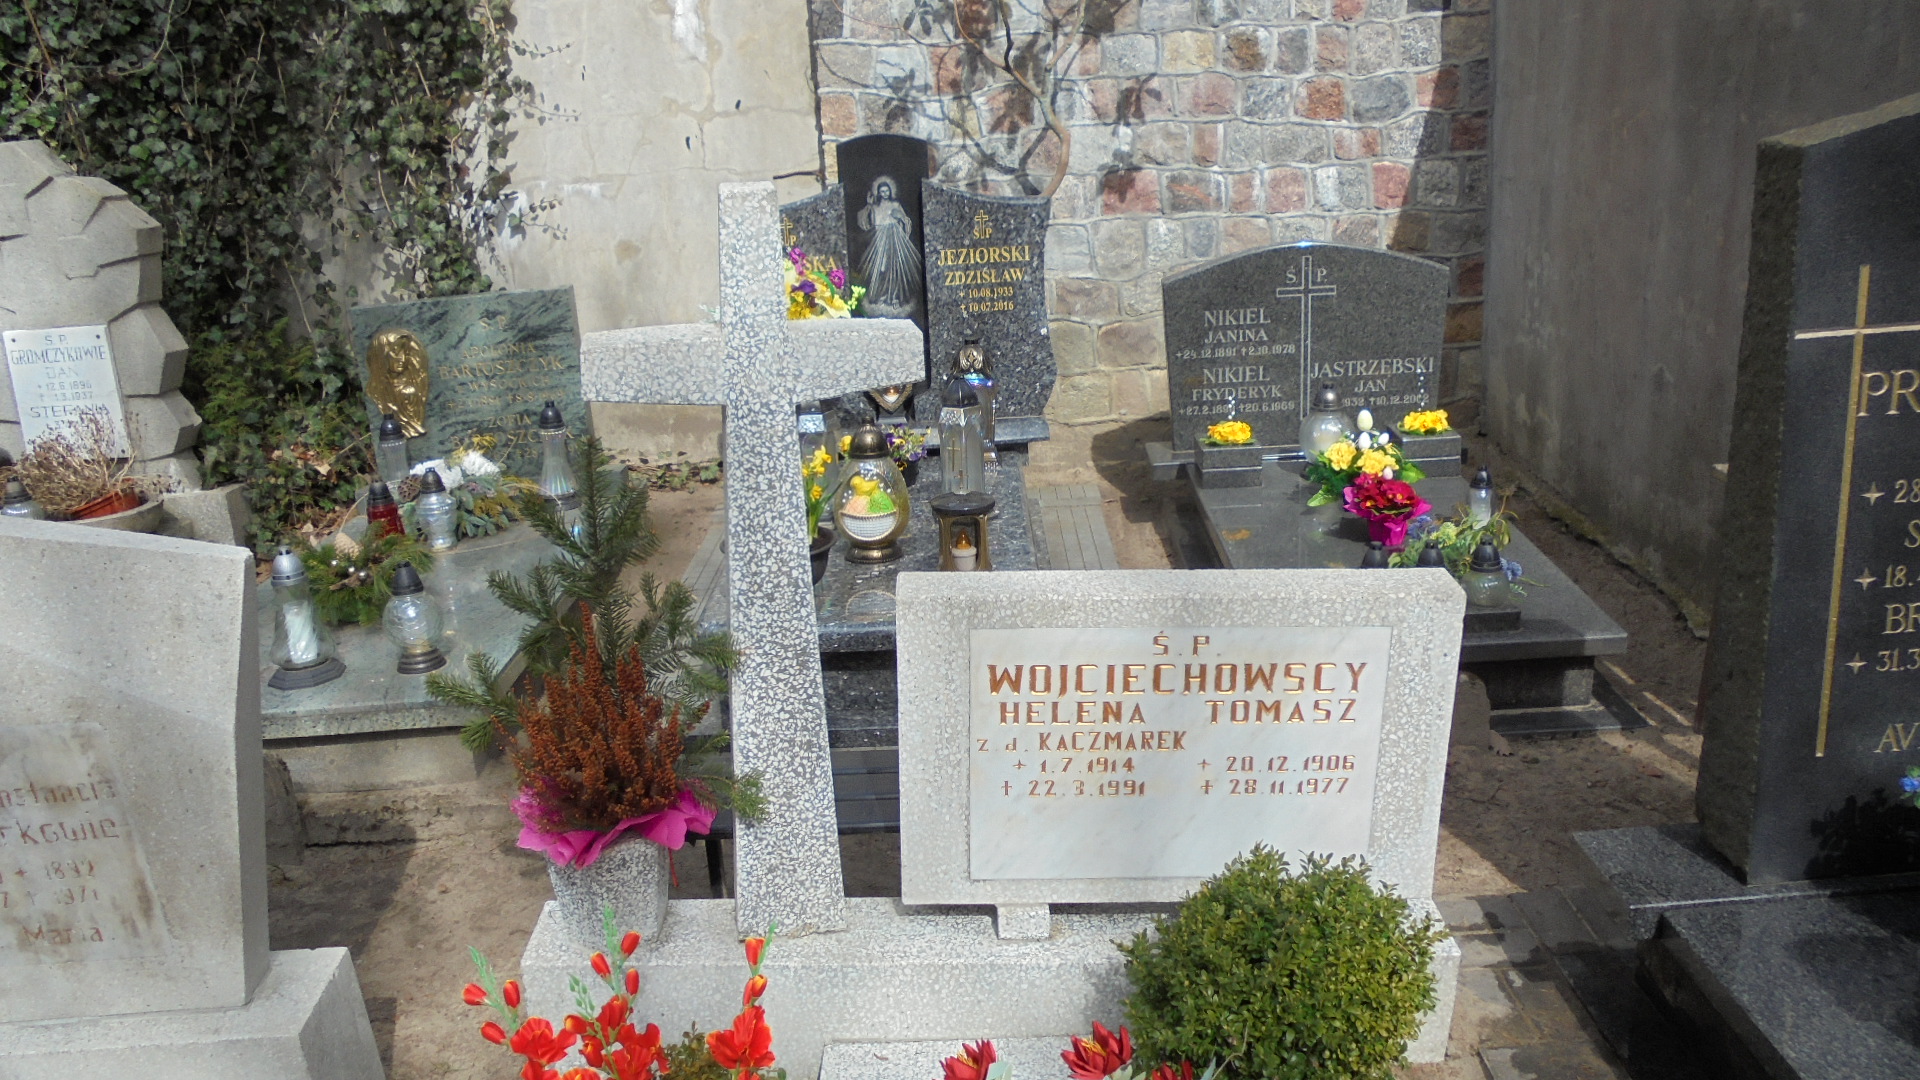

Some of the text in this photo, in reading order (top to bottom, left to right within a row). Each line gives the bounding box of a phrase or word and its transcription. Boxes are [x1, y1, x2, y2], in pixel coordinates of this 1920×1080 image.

[937, 245, 1031, 266] JEZIORSKI
[1204, 307, 1271, 327] NIKIEL
[1204, 327, 1269, 344] JANINA
[1202, 365, 1271, 384] NIKIEL
[1191, 384, 1282, 402] FRYDERYK
[1354, 379, 1387, 393] JAN
[986, 662, 1368, 699] WOJCIECHOWSCY
[998, 698, 1357, 726] HELENA TOMASZ
[1038, 730, 1188, 752] KACZMAREK
